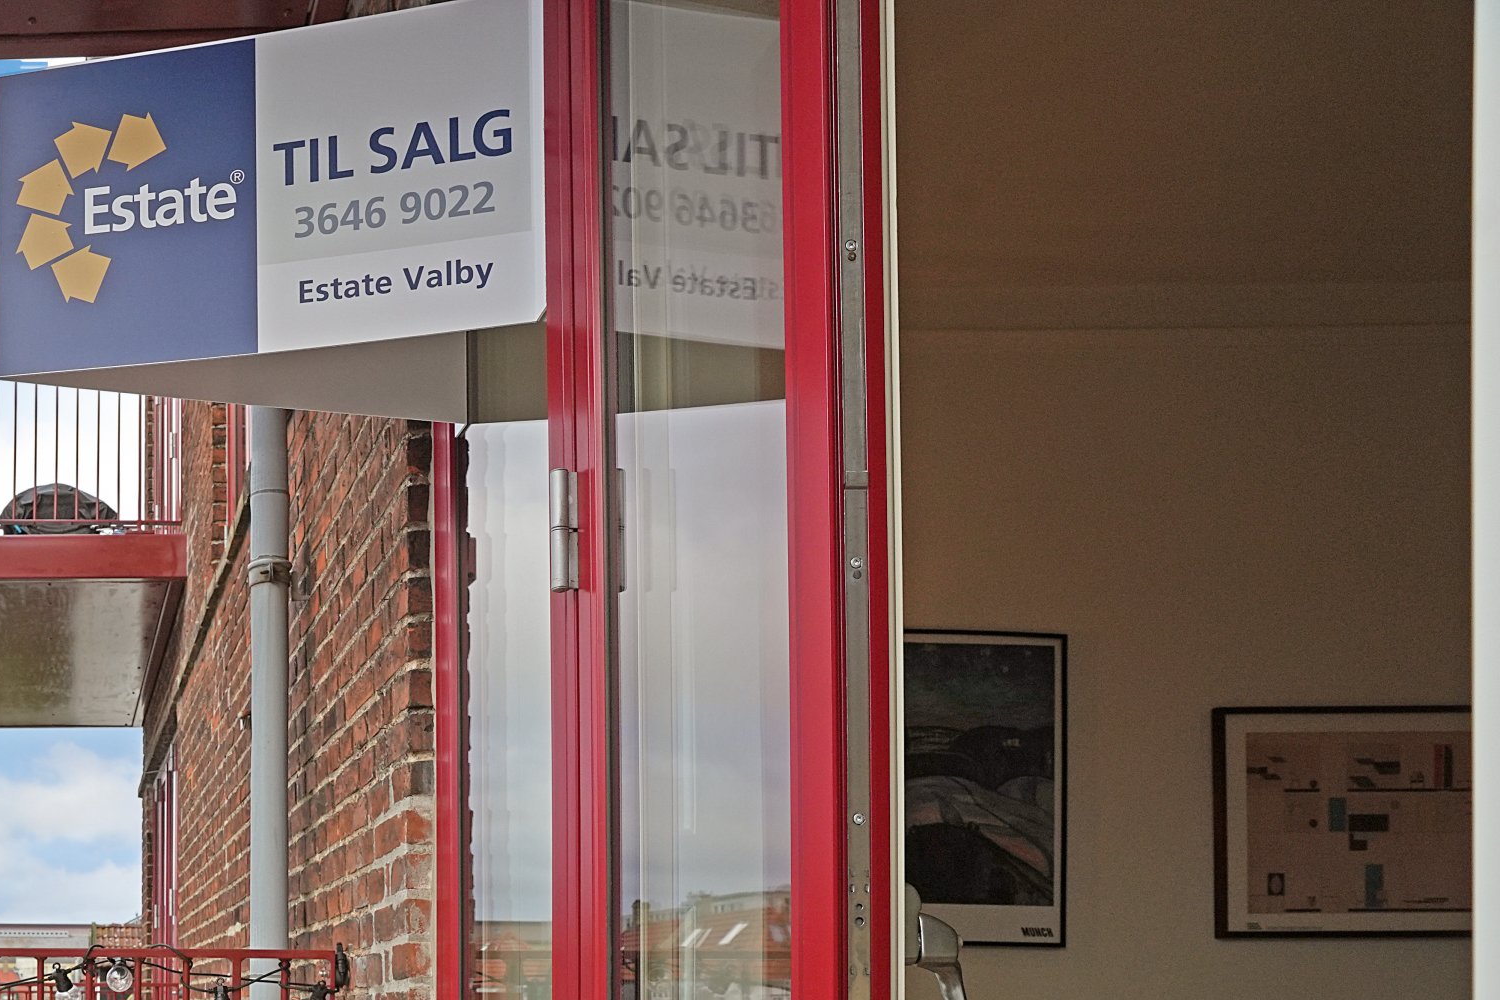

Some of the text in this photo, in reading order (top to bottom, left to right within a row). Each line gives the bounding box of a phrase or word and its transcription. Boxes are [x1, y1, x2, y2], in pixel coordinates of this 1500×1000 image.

[273, 109, 512, 186] TIL SALG
[294, 181, 496, 238] 3646 9022
[299, 259, 494, 304] Estate Valby
[1021, 926, 1054, 938] MUNCH
